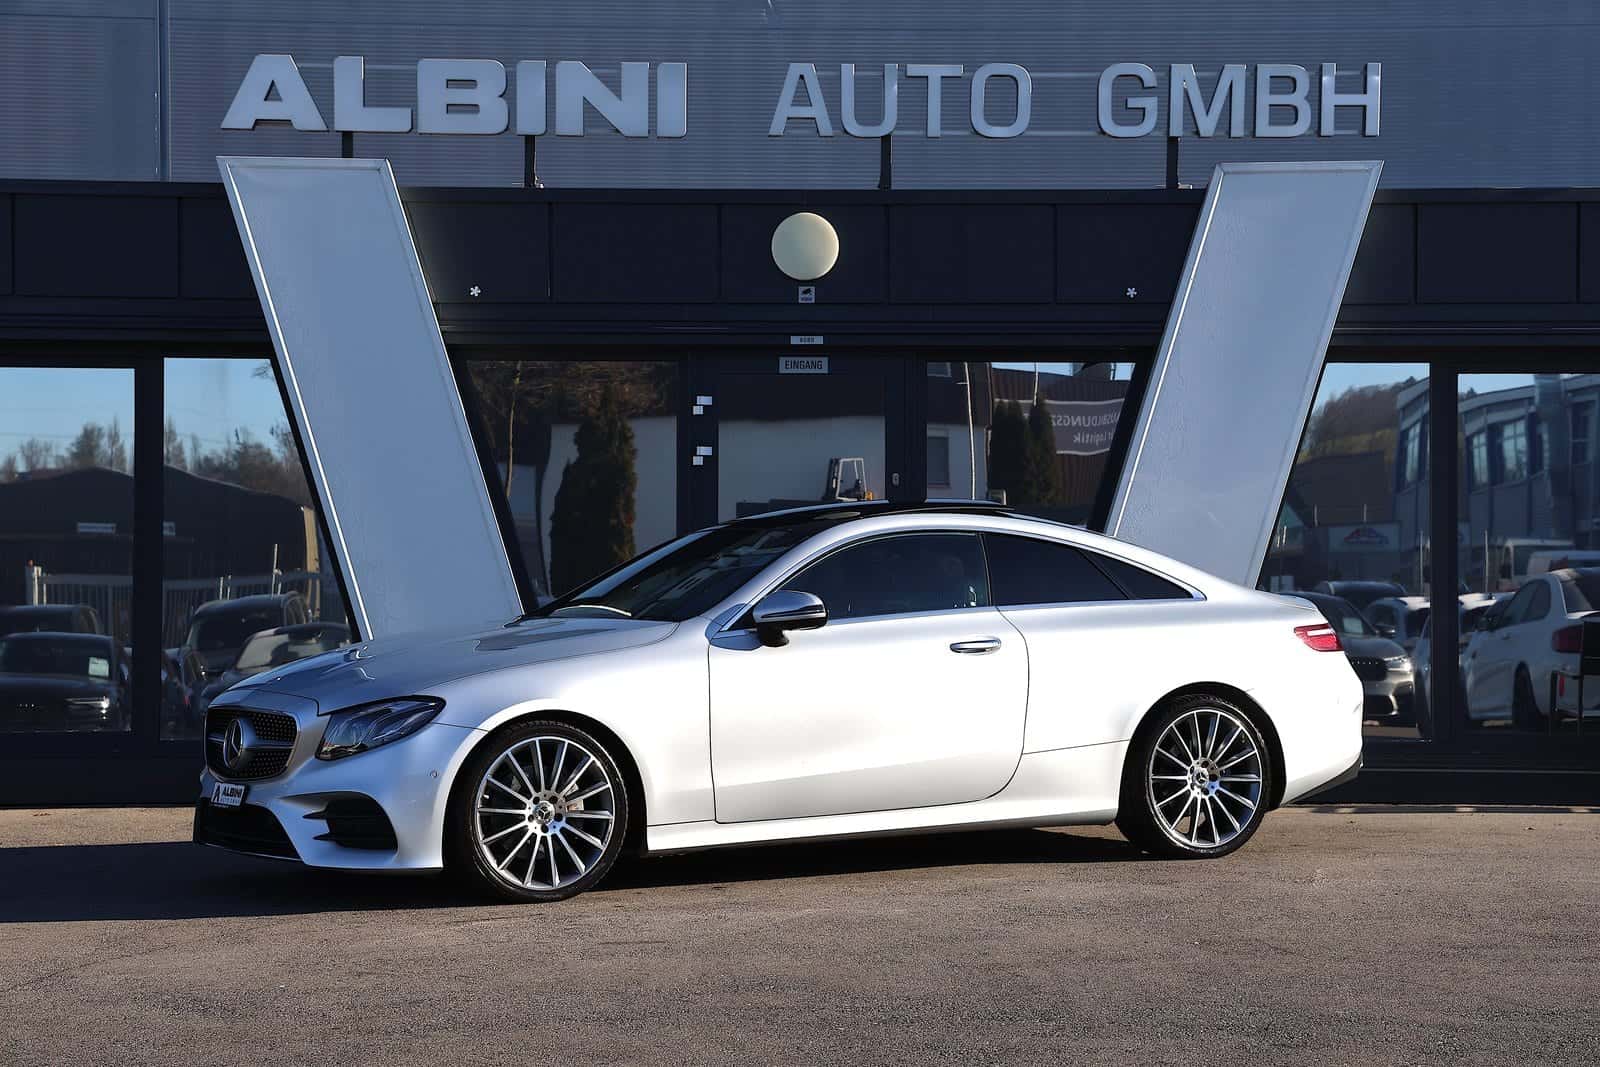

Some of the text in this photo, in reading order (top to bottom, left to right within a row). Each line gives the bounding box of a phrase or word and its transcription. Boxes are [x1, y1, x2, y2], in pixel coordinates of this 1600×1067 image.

[220, 54, 1382, 138] ALBINI AUTO GMBH
[784, 359, 824, 370] EINGANG
